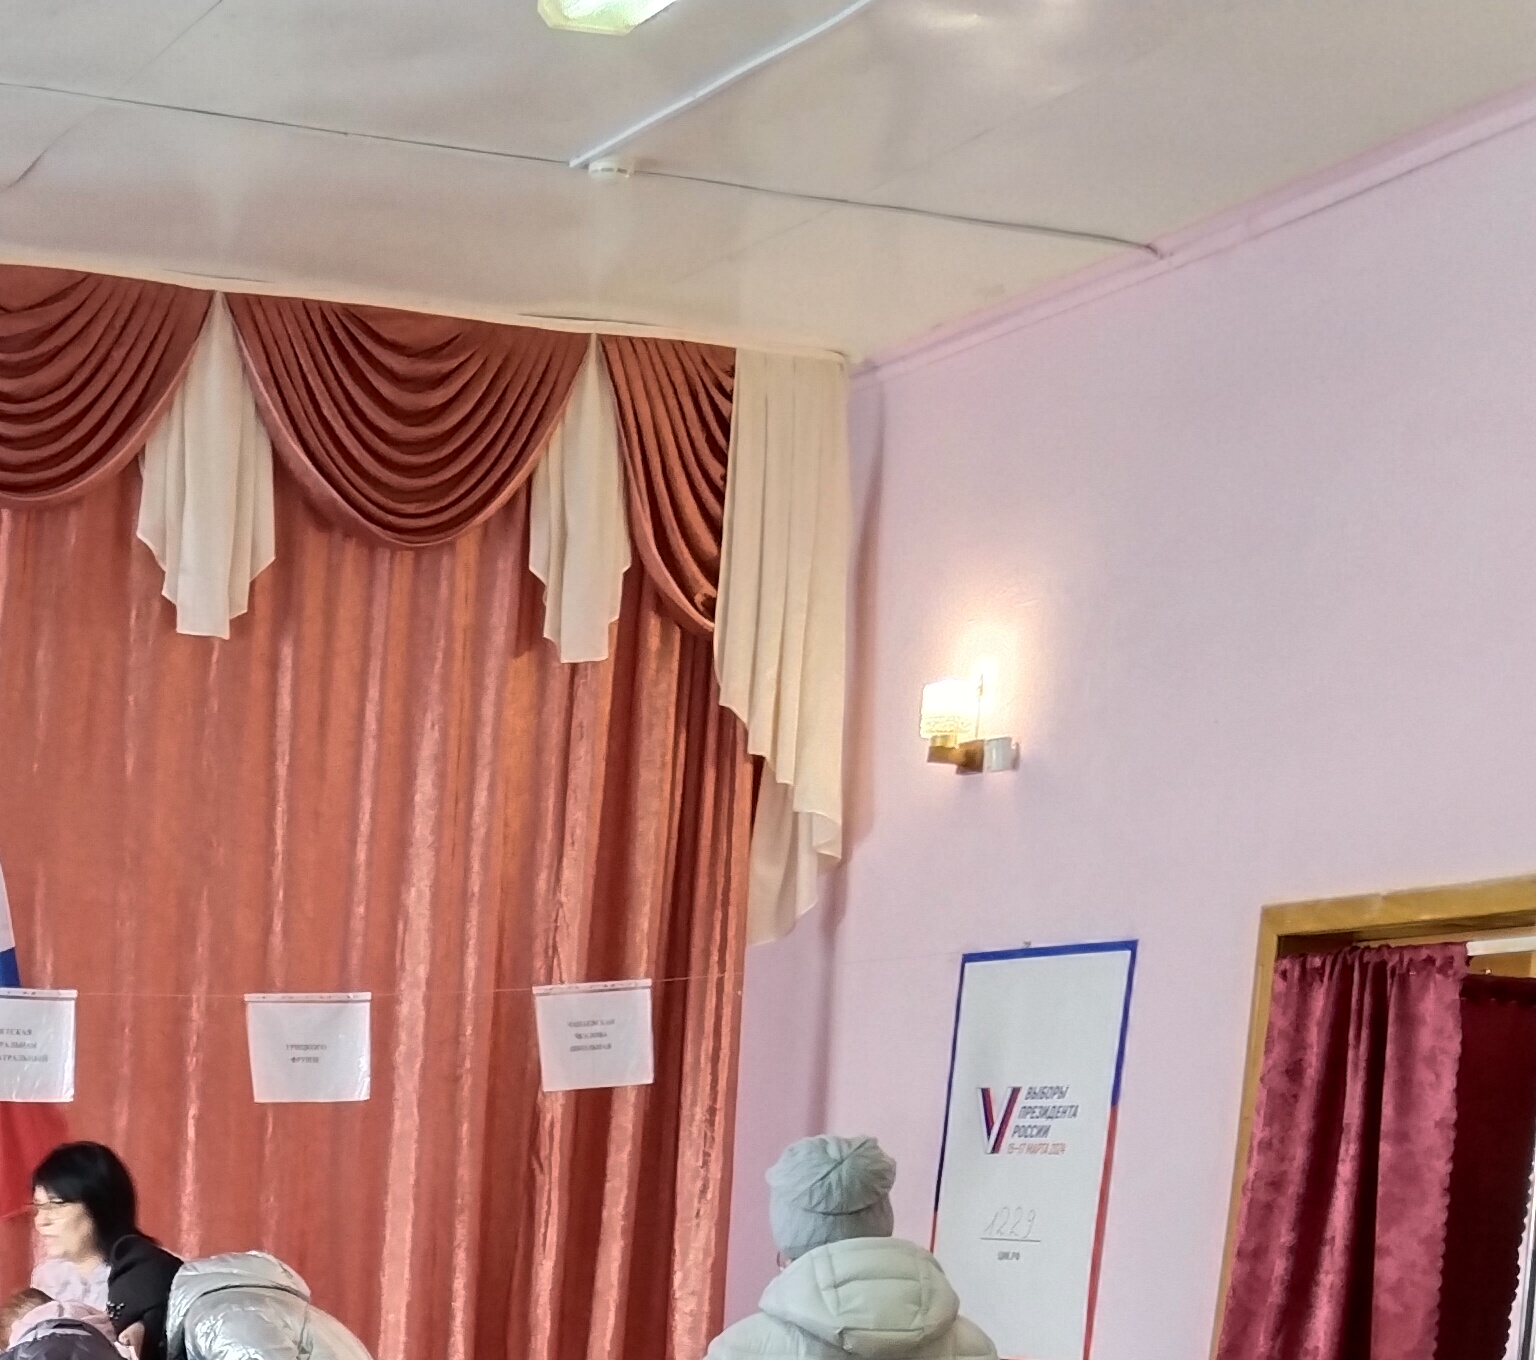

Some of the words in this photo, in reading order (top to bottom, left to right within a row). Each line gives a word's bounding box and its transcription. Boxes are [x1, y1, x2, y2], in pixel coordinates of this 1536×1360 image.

[1024, 1085, 1070, 1100] ВЫБОРЫ
[1018, 1105, 1080, 1121] ПРЕЗИДЕНТА
[1011, 1124, 1052, 1138] РОССИИ
